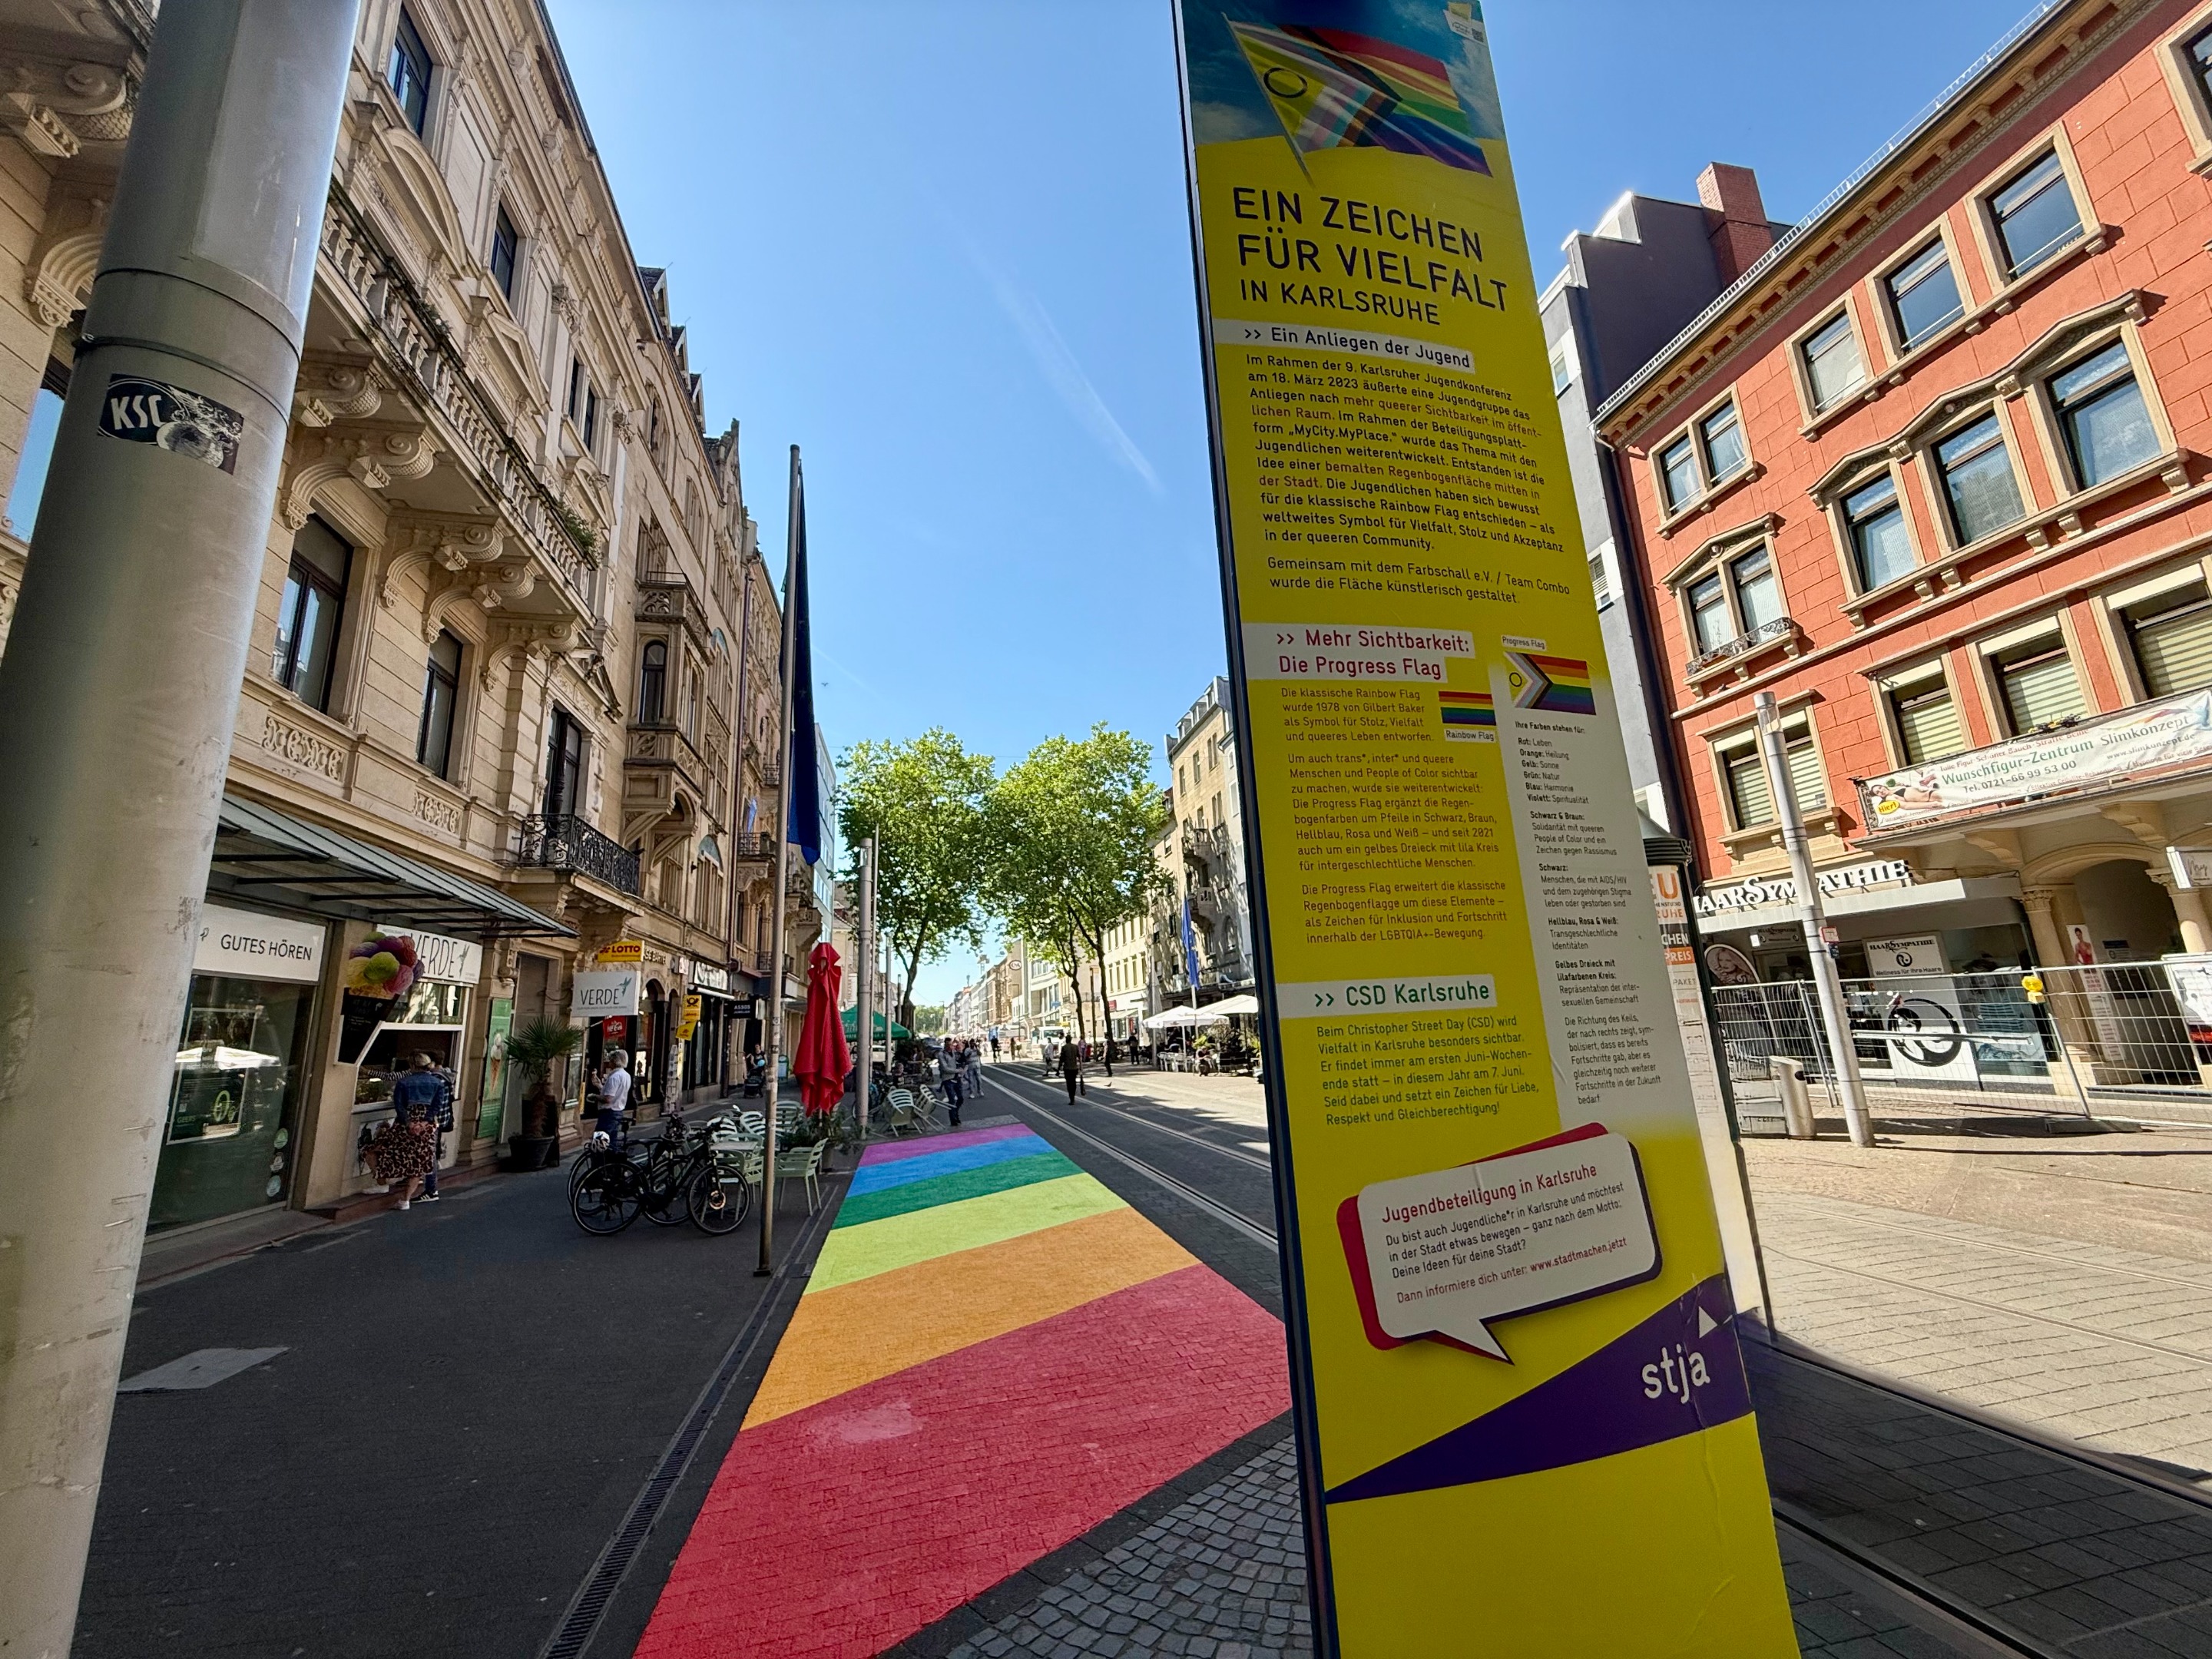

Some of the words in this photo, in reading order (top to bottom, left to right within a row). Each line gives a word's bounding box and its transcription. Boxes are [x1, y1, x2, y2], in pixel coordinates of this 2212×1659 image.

[1233, 187, 1302, 224] EIN
[1320, 197, 1483, 262] ZEICHEN
[1237, 227, 1321, 273] FÜR
[1336, 243, 1508, 312] VIELFALT
[1240, 280, 1269, 302] IN
[1281, 282, 1441, 326] KARLSRUHE
[1271, 326, 1298, 343] Ein
[1305, 329, 1379, 353] Anliegen
[1384, 339, 1409, 356] der
[1415, 344, 1470, 369] Jugend
[1246, 353, 1263, 366] Im
[1267, 355, 1319, 369] Rahmen
[1322, 359, 1340, 372] der
[1345, 361, 1357, 373] 9.
[1359, 363, 1419, 381] Karlsruher
[1424, 373, 1512, 402] Jugendkonferenz
[1248, 373, 1268, 382] am
[1272, 372, 1290, 384] 18.
[1293, 373, 1324, 386] März
[1327, 376, 1359, 389] 2023
[1363, 379, 1408, 396] äußerte
[1411, 386, 1434, 400] eine
[1438, 390, 1510, 416] Jugendgruppe
[1512, 408, 1530, 421] das
[111, 395, 165, 430] KSC
[1250, 387, 1306, 403] Anliegen
[1310, 392, 1339, 404] nach
[1343, 396, 1373, 408] mehr
[1378, 399, 1421, 413] queerer
[1425, 404, 1489, 426] Sichtbarkeit
[1492, 417, 1505, 429] im
[1507, 421, 1541, 438] öffent-
[1251, 404, 1291, 417] lichen
[1296, 406, 1335, 420] Raum.
[1338, 409, 1354, 422] Im
[1358, 412, 1407, 428] Rahmen
[1410, 418, 1428, 431] der
[1432, 421, 1525, 449] Beteiligungsplatt-
[1253, 421, 1283, 435] form
[1401, 435, 1436, 448] wurde
[1439, 439, 1459, 452] das
[1462, 442, 1497, 459] Thema
[1499, 452, 1517, 463] mit
[1519, 455, 1537, 469] den
[1267, 556, 1346, 571] Gemeinsam
[1350, 560, 1373, 572] mit
[1376, 561, 1403, 574] dem
[1407, 562, 1471, 581] Farbschall
[1473, 570, 1492, 583] e.V.
[1506, 573, 1534, 589] Team
[1536, 578, 1570, 595] Combo
[1270, 576, 1310, 588] wurde
[1315, 576, 1334, 589] die
[1339, 577, 1382, 591] Fläche
[1386, 579, 1462, 597] künstlerisch
[1305, 629, 1351, 647] Mehr
[1358, 630, 1469, 652] Sichtbarkeit:
[1502, 635, 1530, 647] Progress
[1531, 638, 1545, 651] Flag
[1279, 655, 1308, 674] Die
[1316, 656, 1396, 678] Progress
[1402, 657, 1442, 680] Flag
[1281, 687, 1297, 697] Die
[1300, 687, 1353, 698] klassische
[1356, 687, 1396, 698] Rainbow
[1399, 688, 1421, 701] Flag
[1283, 702, 1313, 712] wurde
[1316, 701, 1340, 712] 1978
[1363, 702, 1396, 713] Gilbert
[1398, 703, 1425, 714] Baker
[1445, 730, 1477, 740] Rainbow
[1479, 731, 1495, 742] Flag
[1942, 740, 2094, 785] Wunschfigur-Zentrum
[2100, 716, 2189, 747] Slimkonzept
[1962, 783, 1981, 793] Tel.
[1982, 772, 2025, 790] 0721-66
[2027, 768, 2041, 778] 99
[2045, 764, 2058, 773] 53
[2061, 759, 2078, 770] 00
[1530, 810, 1558, 820] Schwarz
[1564, 812, 1584, 821] Braun:
[220, 934, 266, 955] GUTES
[269, 939, 312, 961] HÖREN
[611, 945, 641, 953] LOTTO
[1555, 960, 1578, 969] Gelbes
[1578, 959, 1604, 968] Dreieck
[1604, 959, 1616, 968] mit
[580, 988, 620, 1005] VERDE
[1346, 985, 1386, 1007] CSD
[1394, 980, 1489, 1005] Karlsruhe
[1316, 1025, 1344, 1038] Beim
[1347, 1022, 1408, 1037] Christopher
[1411, 1019, 1443, 1032] Street
[1445, 1018, 1465, 1032] Day
[1467, 1015, 1495, 1031] (CSD)
[1496, 1015, 1518, 1027] wird
[1564, 1016, 1576, 1026] Die
[1577, 1015, 1608, 1026] Richtung
[1608, 1015, 1621, 1024] des
[1621, 1013, 1639, 1023] Keils,
[1575, 1079, 1616, 1091] Fortschritte
[1616, 1078, 1624, 1088] in
[1624, 1078, 1636, 1087] der
[1636, 1075, 1661, 1086] Zukunft
[1382, 1184, 1517, 1224] Jugendbeteiligung
[1518, 1178, 1533, 1194] in
[1535, 1164, 1597, 1190] Karlsruhe
[1396, 1290, 1423, 1304] Dann
[1425, 1278, 1476, 1297] informiere
[1478, 1271, 1498, 1285] dich
[1500, 1266, 1528, 1280] unter:
[1529, 1236, 1628, 1272] www.stadtmachen.jetzt
[1641, 1343, 1711, 1405] stja
